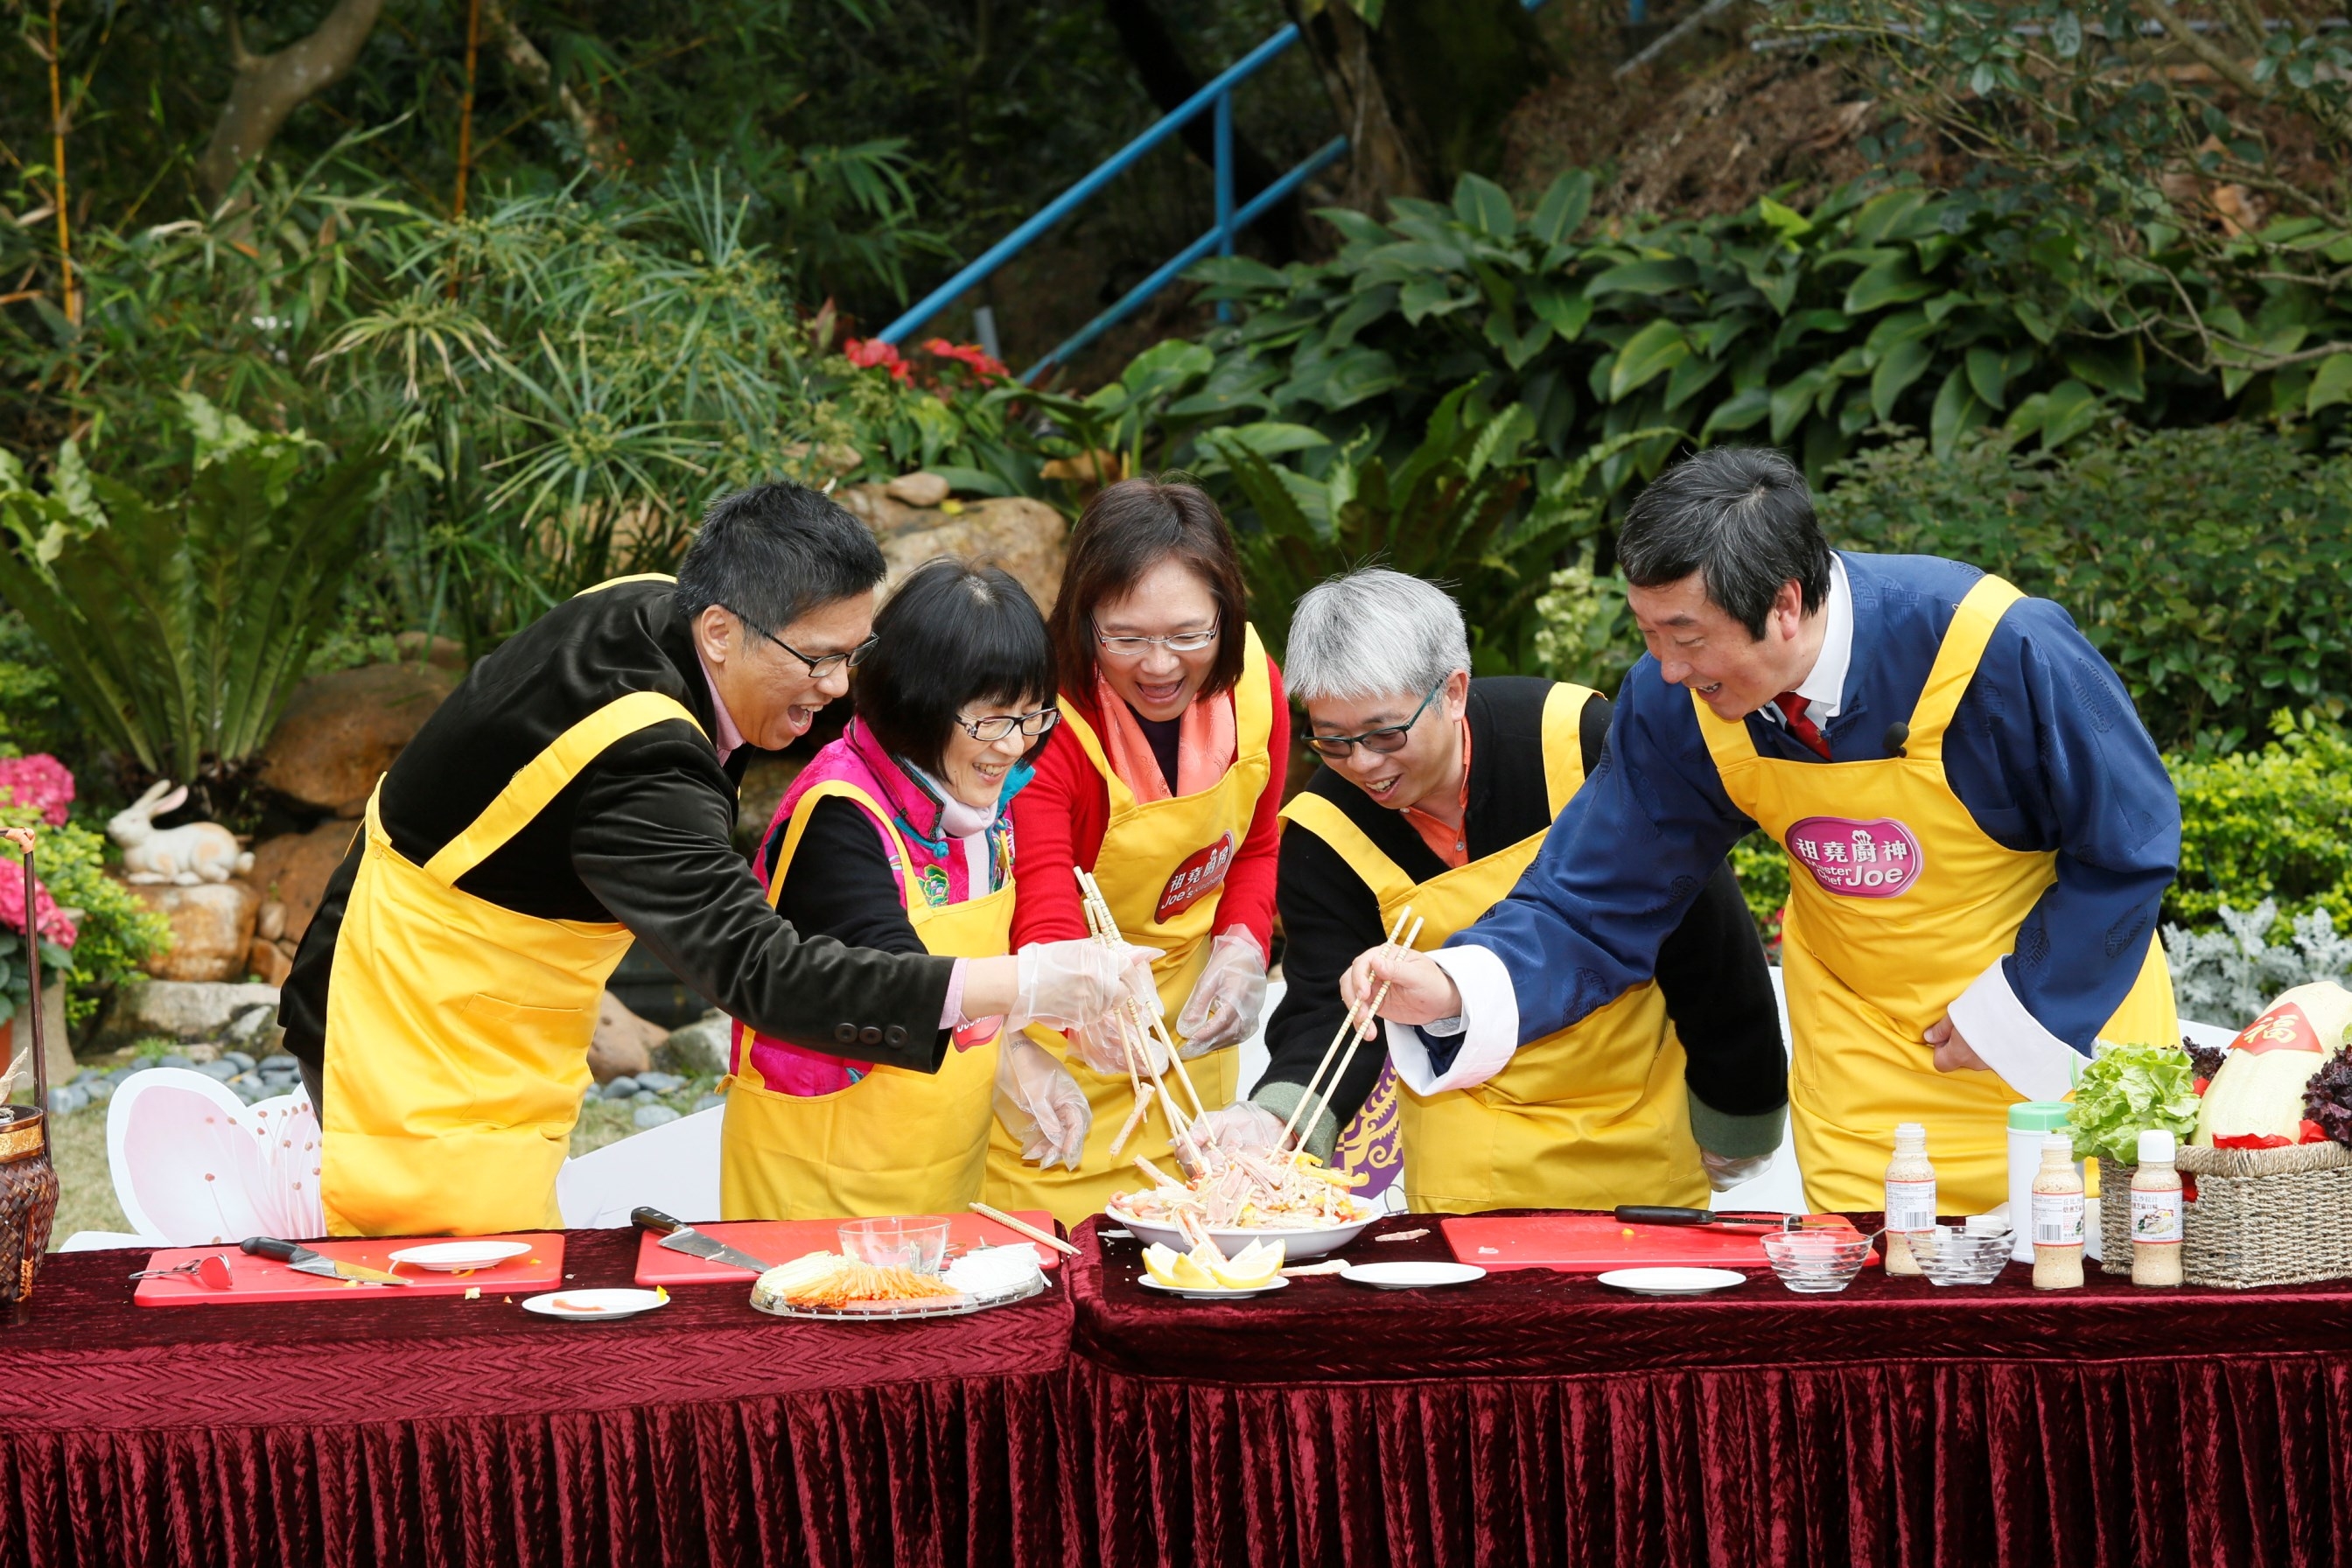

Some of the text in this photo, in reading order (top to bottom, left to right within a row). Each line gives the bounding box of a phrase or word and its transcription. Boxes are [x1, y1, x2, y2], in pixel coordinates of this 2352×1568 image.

[1796, 831, 1908, 863] 祖堯廚神
[1169, 846, 1228, 893] 祖堯廚房
[1805, 858, 1852, 876] Master
[1816, 865, 1903, 886] Chef Joe
[1160, 886, 1194, 910] Joe's
[2243, 1014, 2300, 1044] 福
